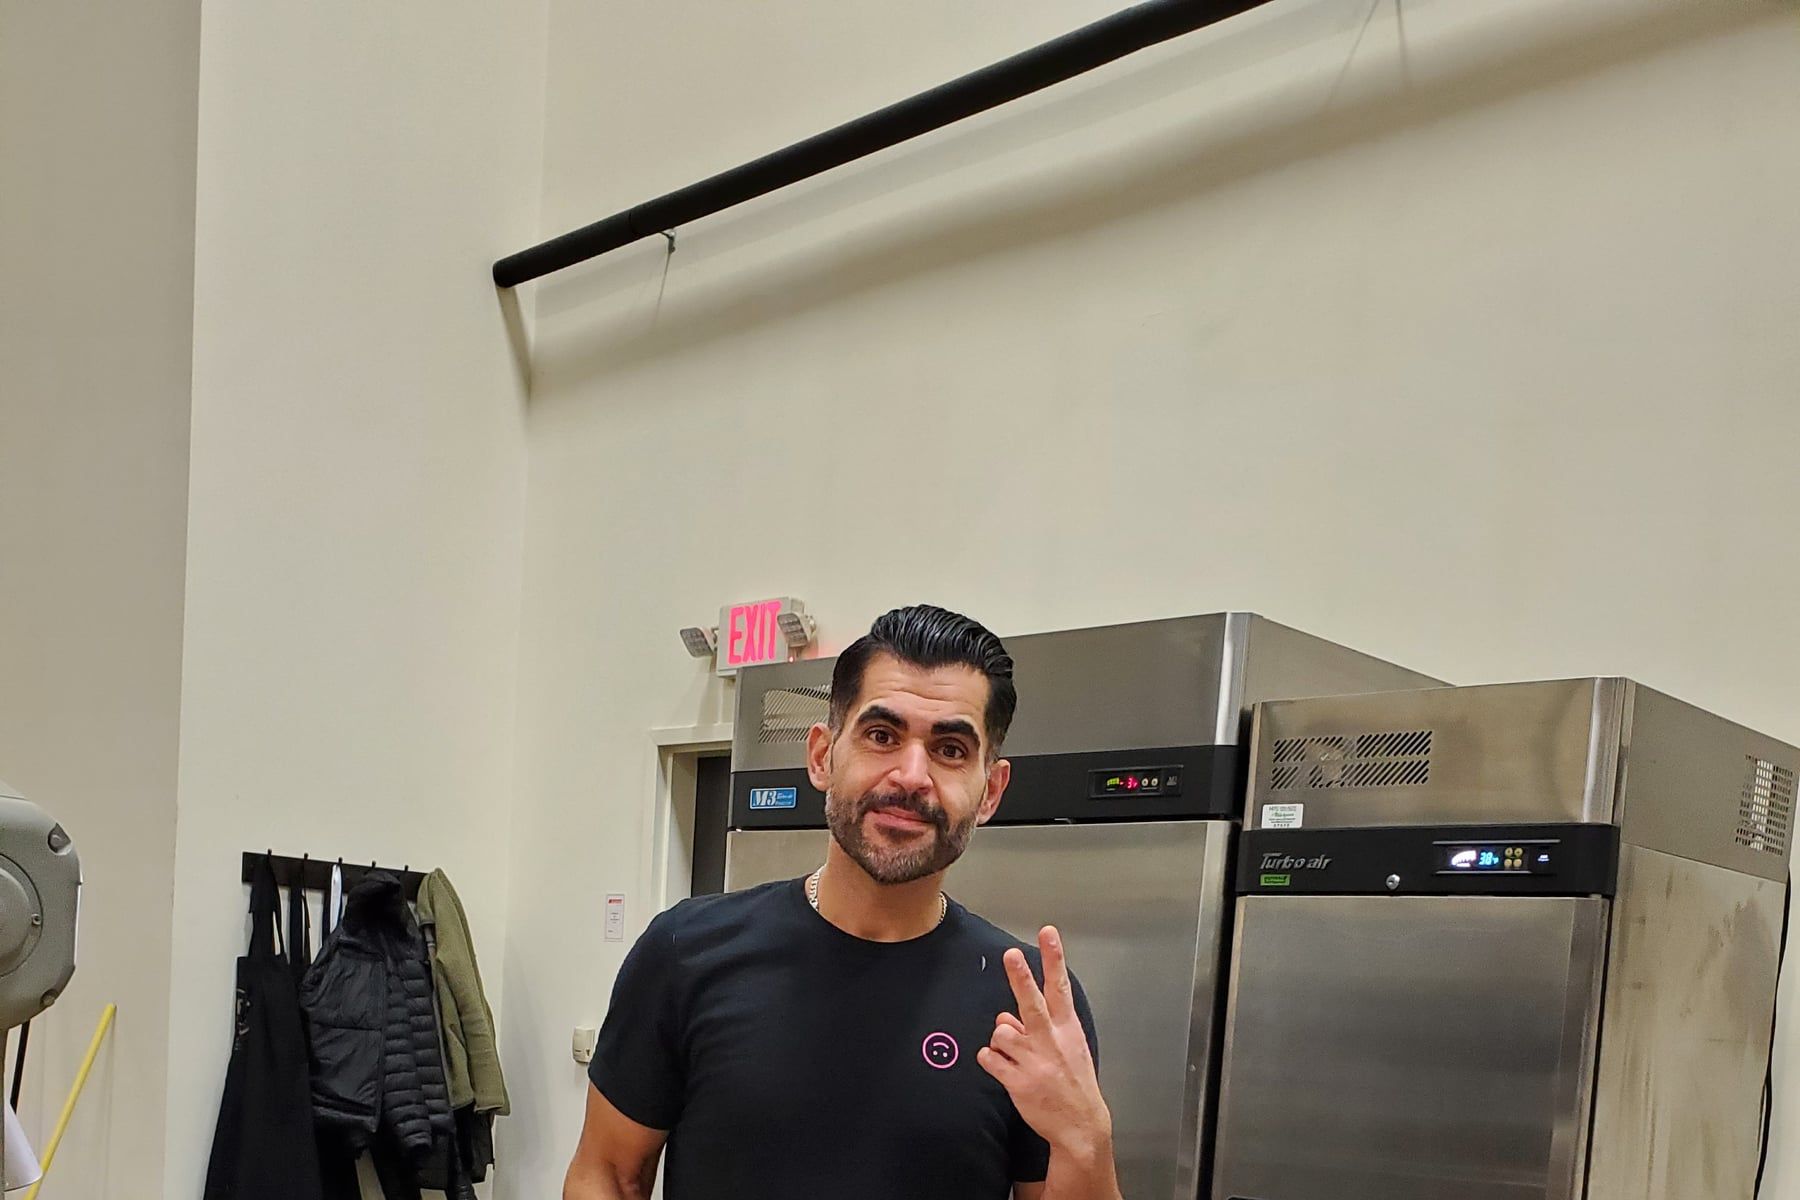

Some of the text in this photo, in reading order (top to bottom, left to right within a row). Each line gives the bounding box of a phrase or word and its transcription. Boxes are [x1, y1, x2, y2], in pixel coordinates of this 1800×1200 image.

[728, 601, 781, 664] EXIT
[1260, 853, 1332, 870] Turbo air
